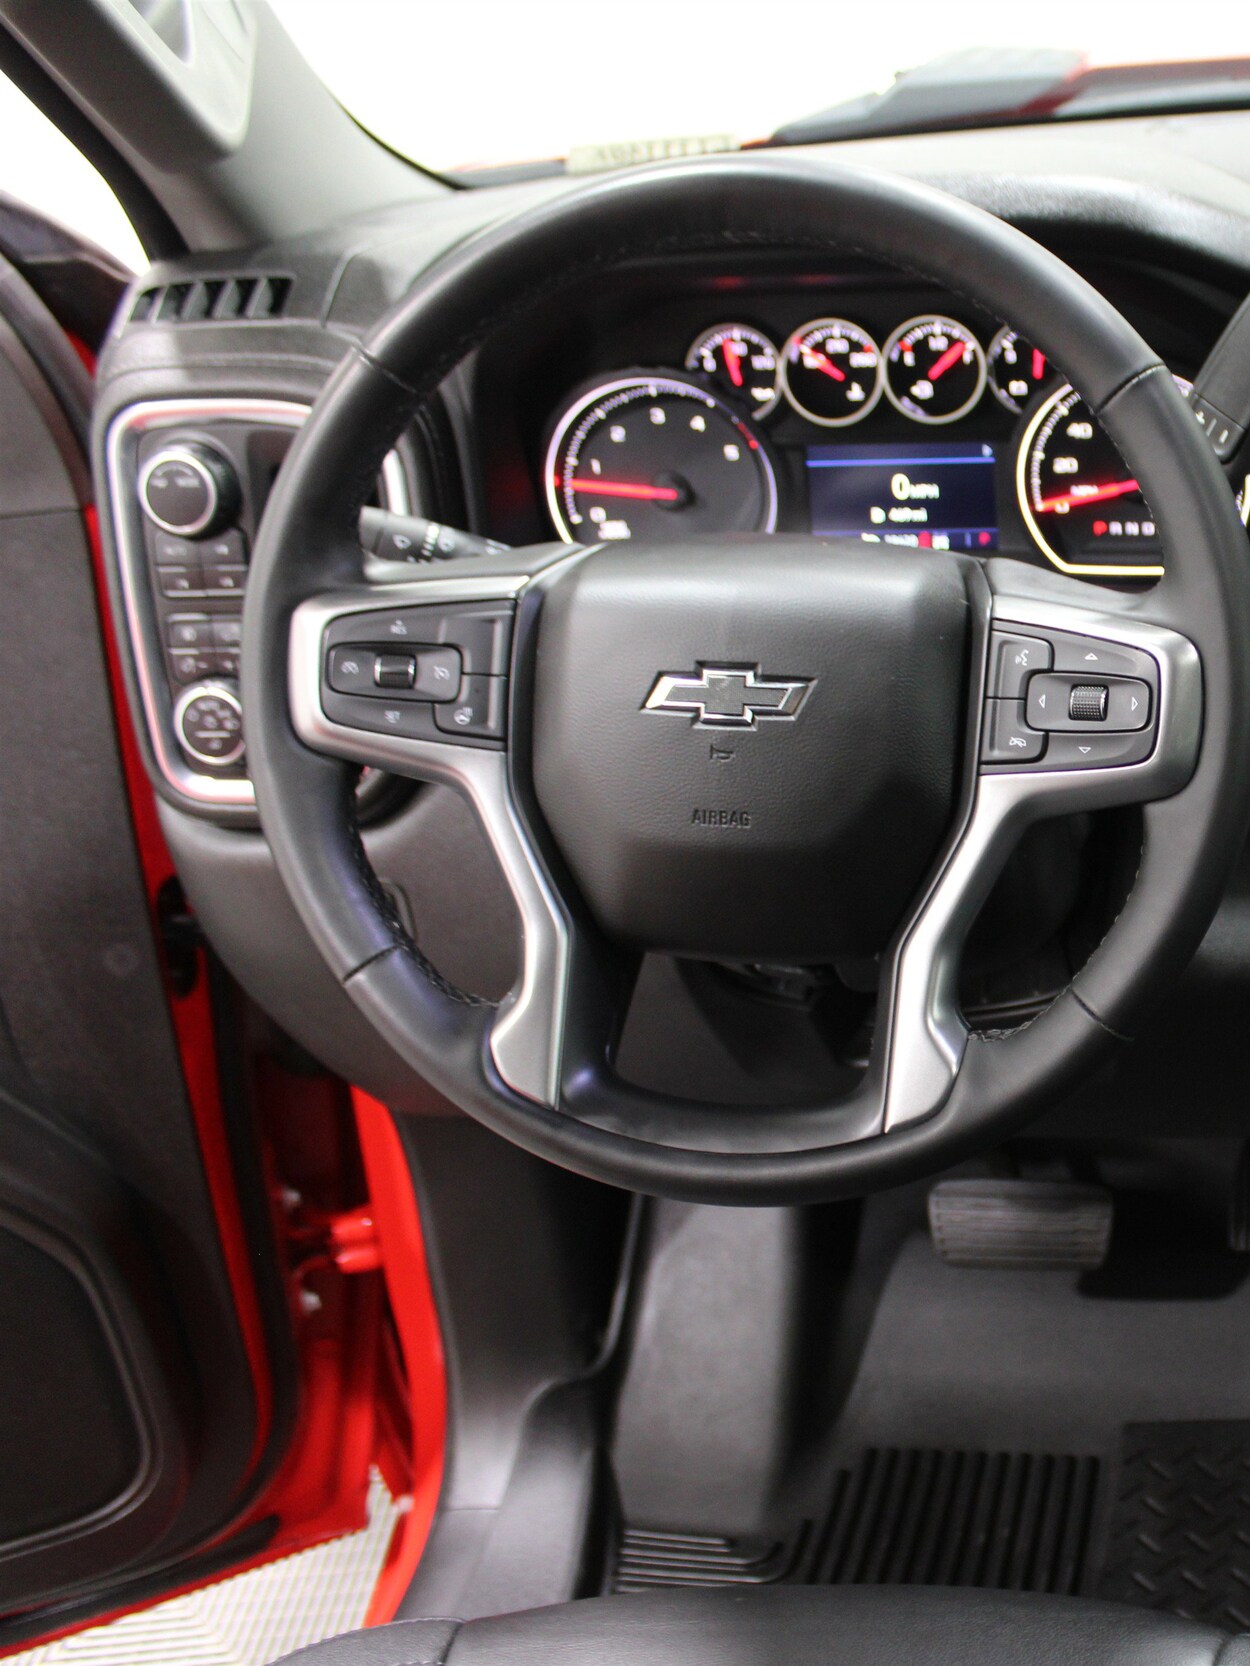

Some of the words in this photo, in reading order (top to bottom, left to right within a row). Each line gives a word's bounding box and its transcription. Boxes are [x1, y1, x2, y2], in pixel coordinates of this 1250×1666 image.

[1066, 422, 1093, 439] 40
[891, 473, 910, 500] 0
[692, 808, 751, 828] AIRBAG
